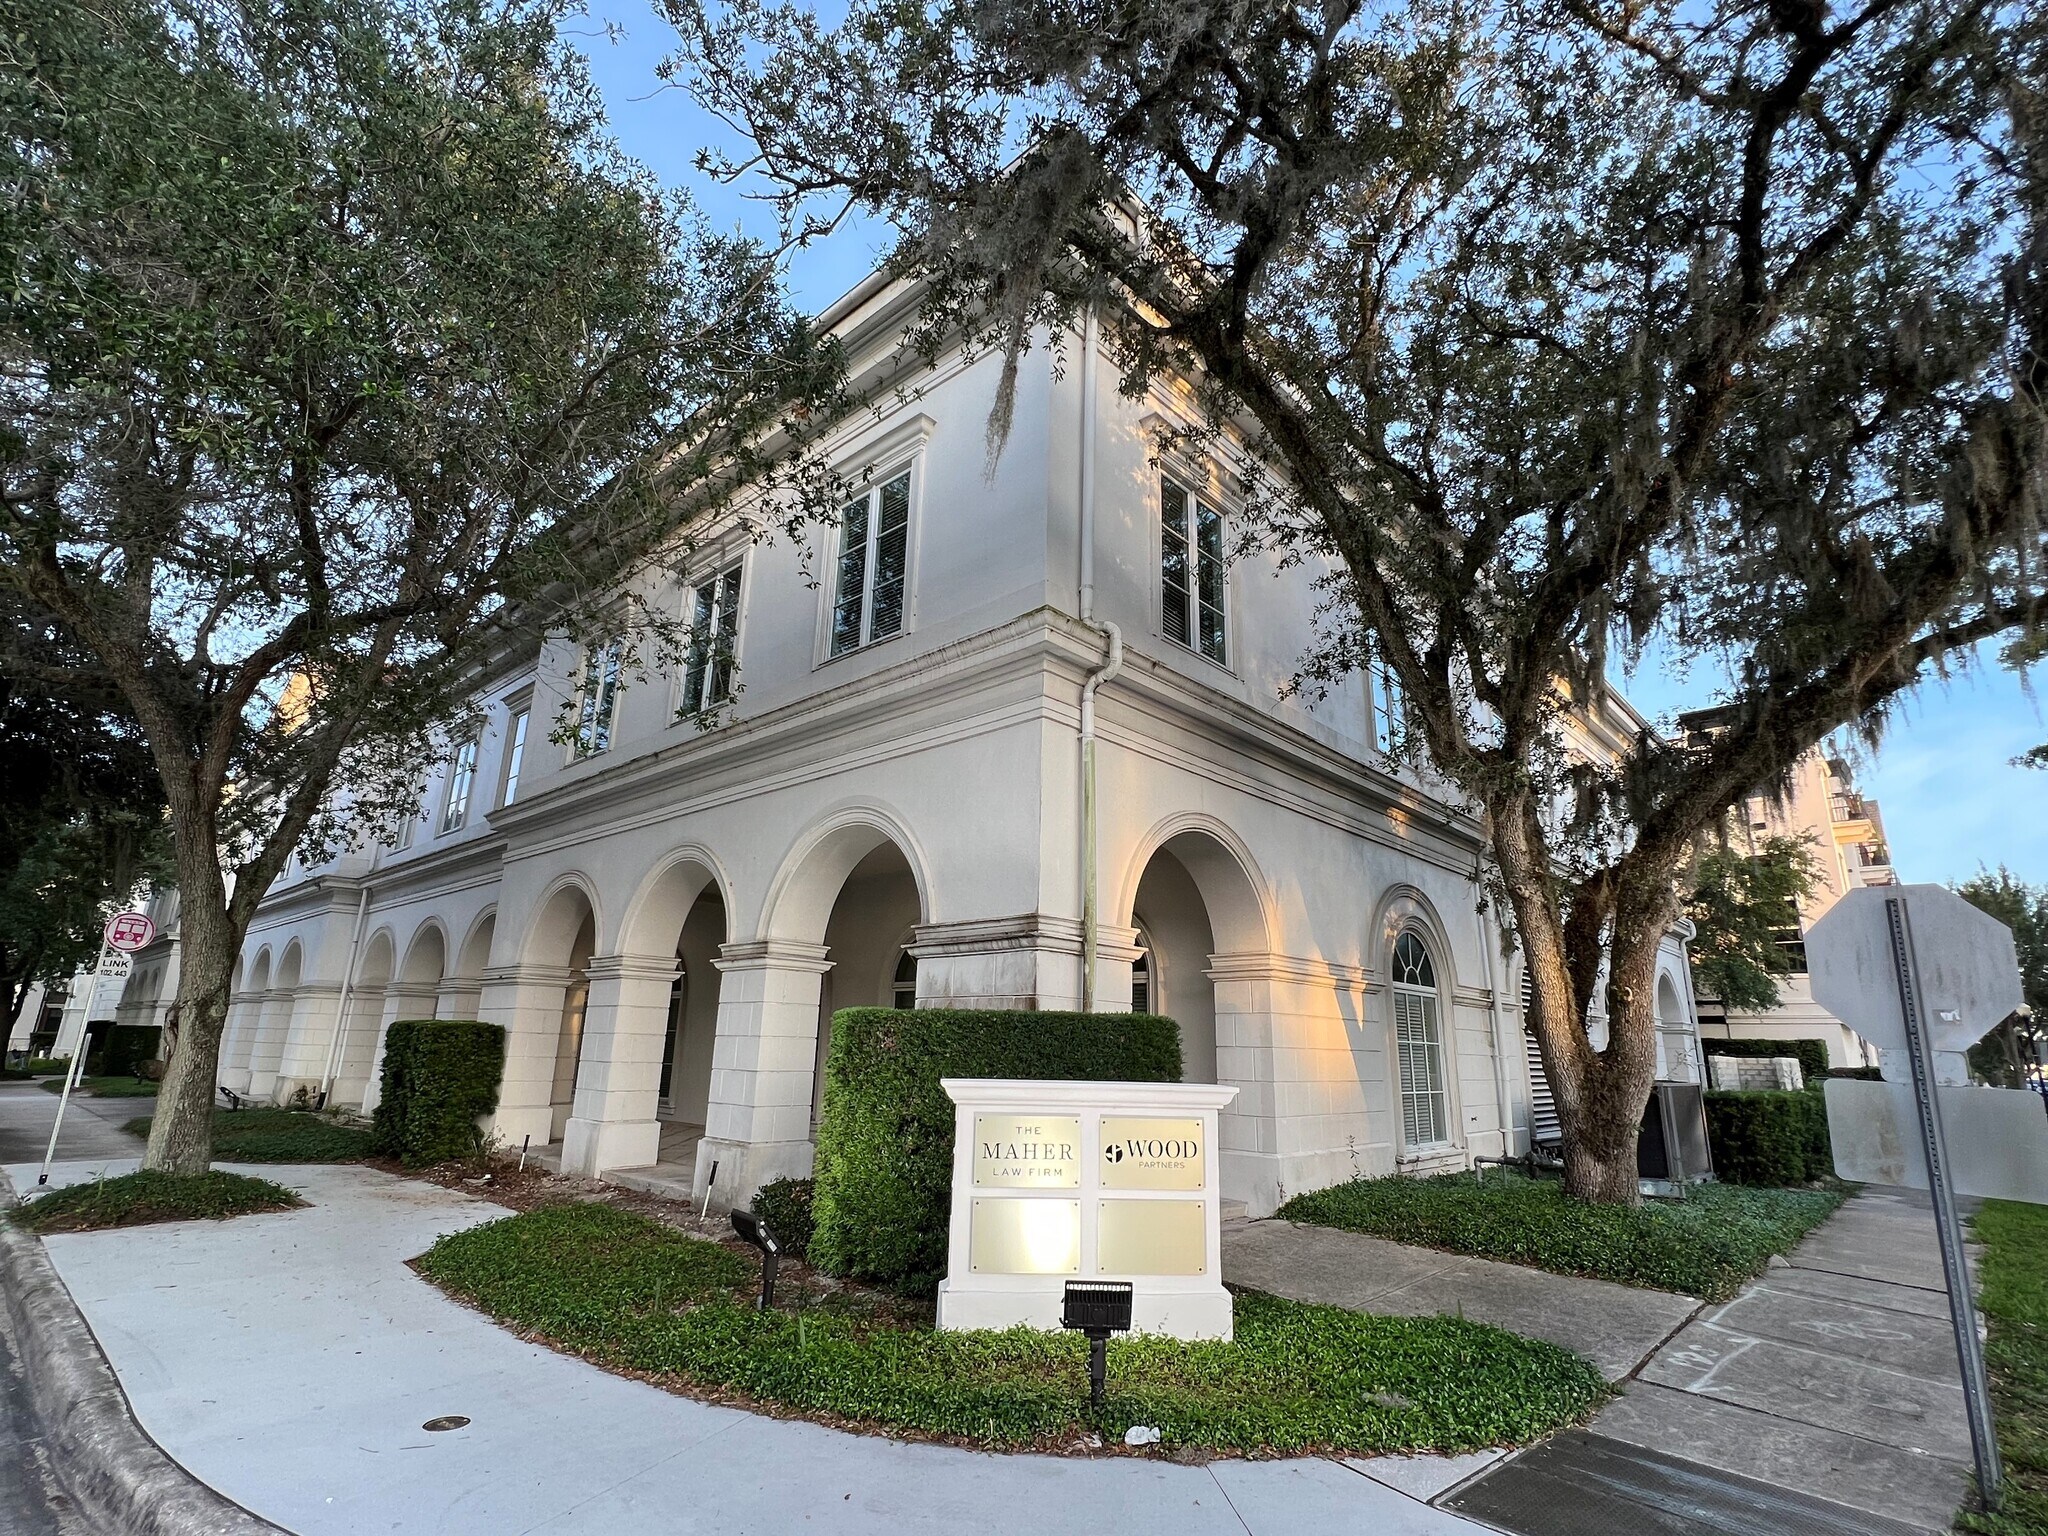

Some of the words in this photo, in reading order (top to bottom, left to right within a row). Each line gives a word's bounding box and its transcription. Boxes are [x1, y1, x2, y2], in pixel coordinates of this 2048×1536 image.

[102, 960, 129, 968] LINK
[1015, 1126, 1041, 1135] THE
[982, 1142, 1074, 1160] MAHER
[1126, 1139, 1198, 1159] WOOD
[1138, 1161, 1185, 1169] PARTNERS
[992, 1167, 1023, 1176] LAW
[1029, 1167, 1063, 1177] FIRM
